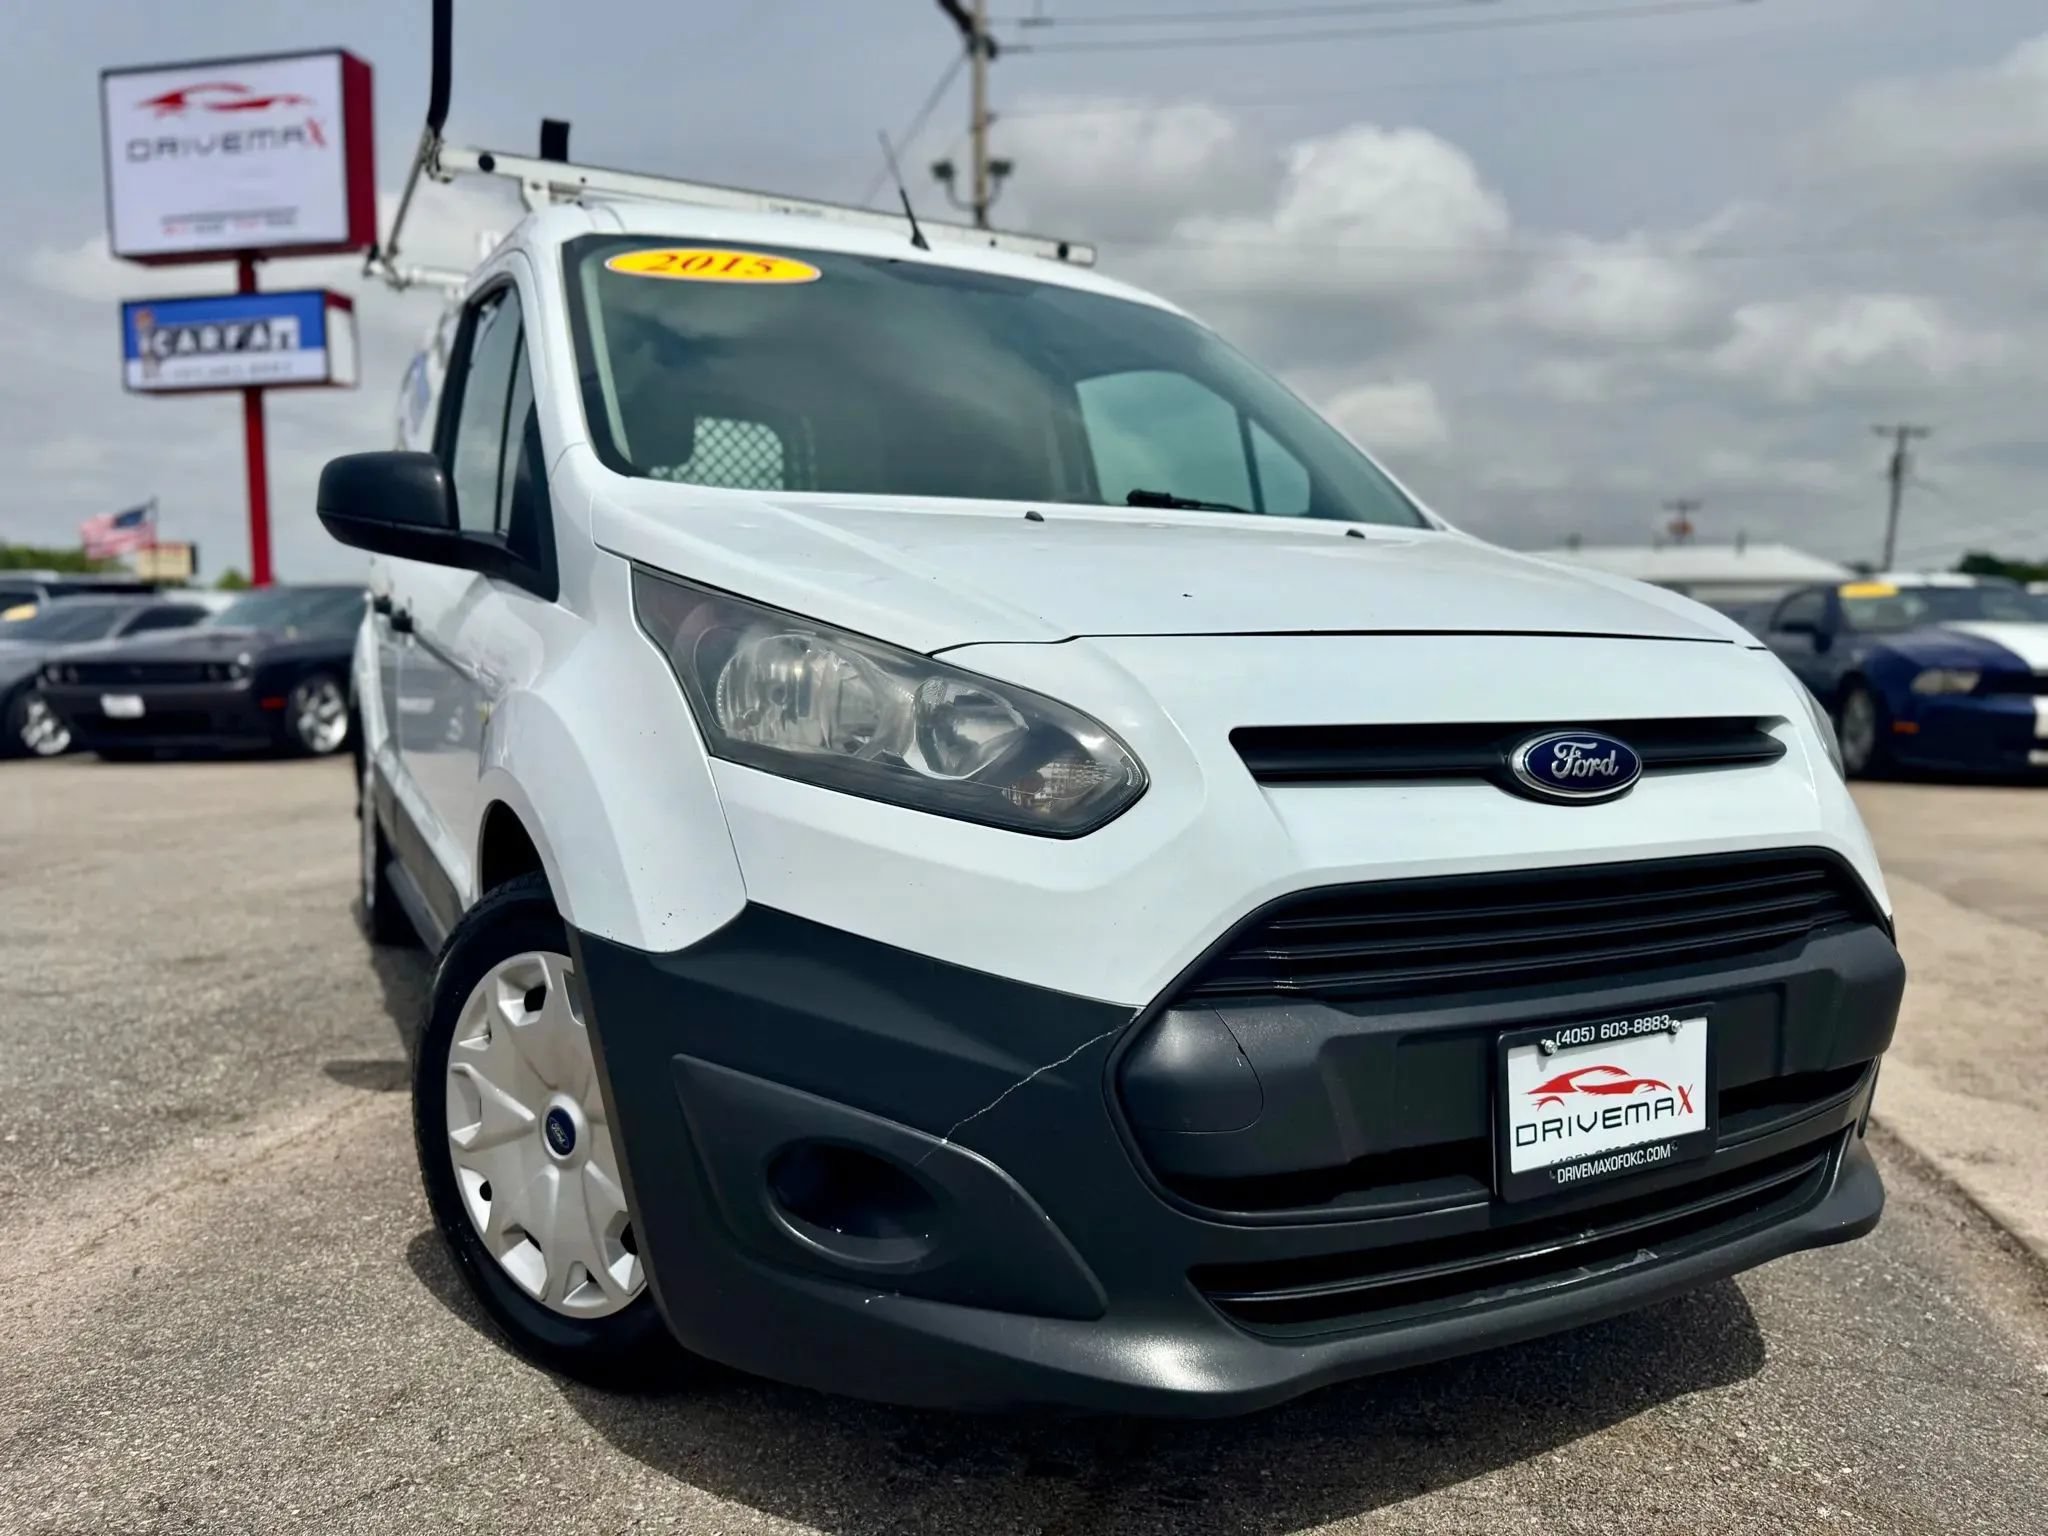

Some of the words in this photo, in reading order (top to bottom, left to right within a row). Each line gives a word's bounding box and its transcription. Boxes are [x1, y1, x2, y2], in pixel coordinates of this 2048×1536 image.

[126, 117, 326, 163] DRIVEMAX
[642, 253, 779, 275] 2015
[1551, 741, 1619, 779] Ford
[1556, 1026, 1595, 1047] (405)
[1600, 1014, 1670, 1039] 603-8883
[1516, 1084, 1694, 1147] DRIVEMAX
[1557, 1144, 1671, 1184] DRIVEMAXOFOKC.COM
